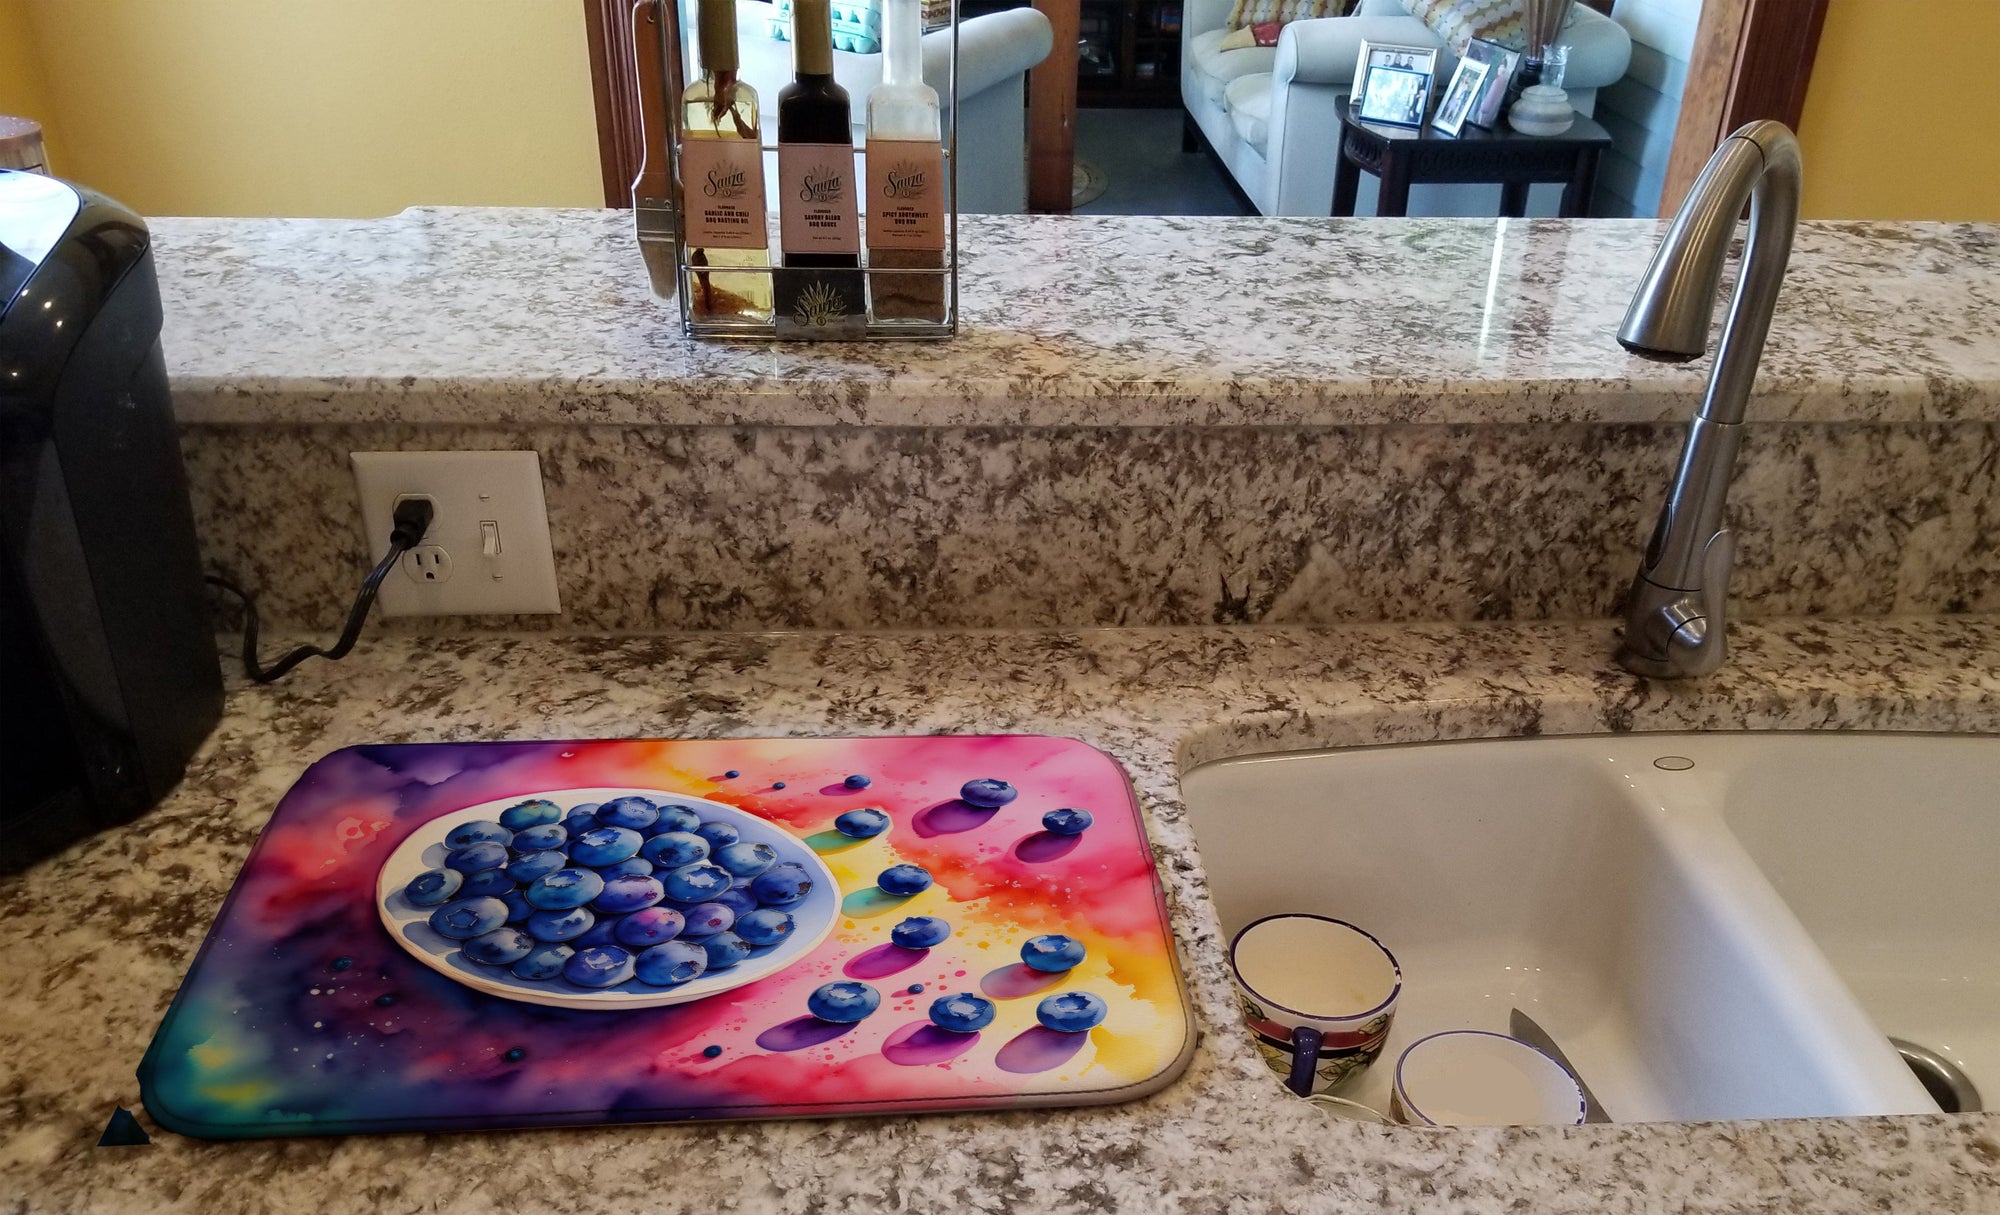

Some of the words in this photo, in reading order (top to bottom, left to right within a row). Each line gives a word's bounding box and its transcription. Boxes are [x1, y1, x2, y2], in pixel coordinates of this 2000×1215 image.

[704, 169, 745, 197] Sauza
[800, 175, 842, 202] Sauza
[884, 171, 925, 198] Sauza
